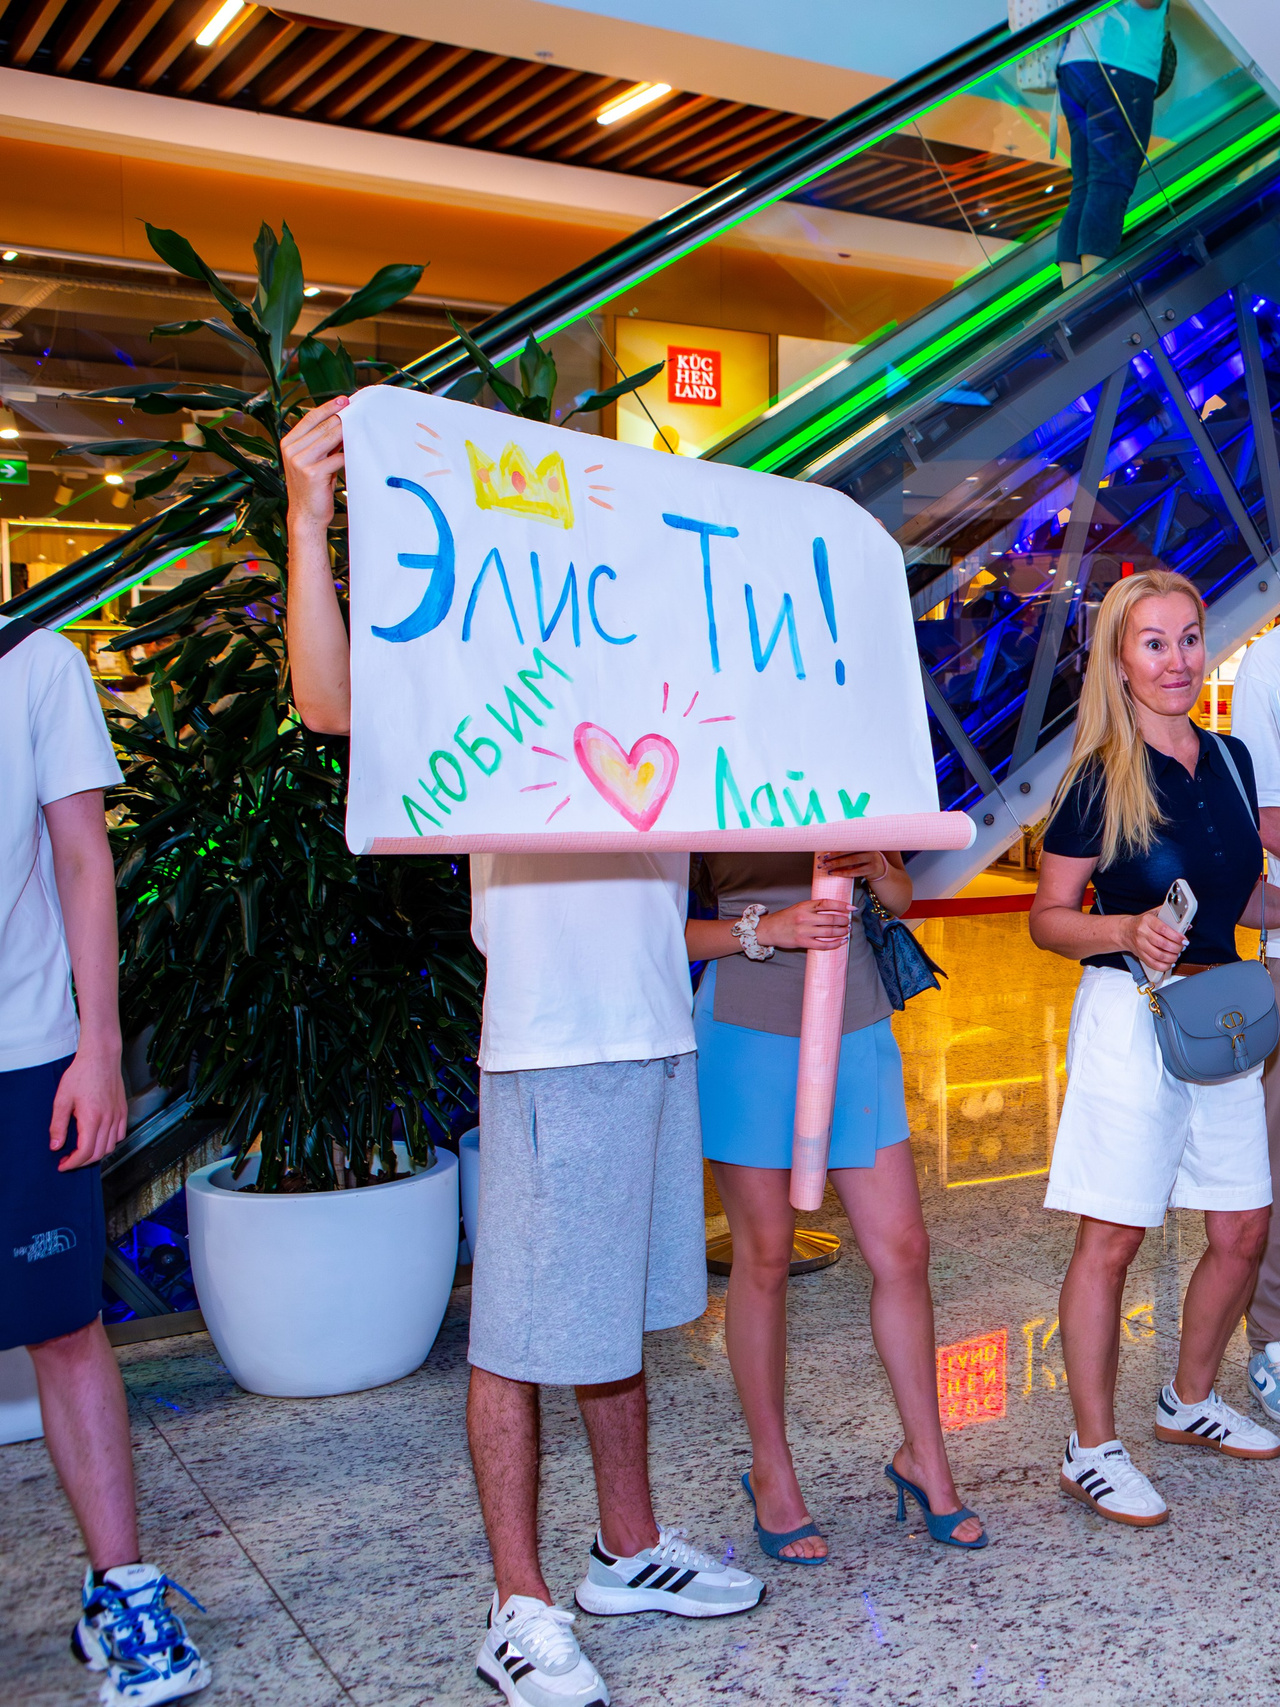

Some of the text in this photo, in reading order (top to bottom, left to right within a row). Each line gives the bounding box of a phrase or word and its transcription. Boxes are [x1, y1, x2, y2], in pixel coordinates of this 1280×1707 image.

[677, 353, 713, 371] KÜC
[677, 369, 713, 385] HEN
[675, 383, 717, 400] LAND
